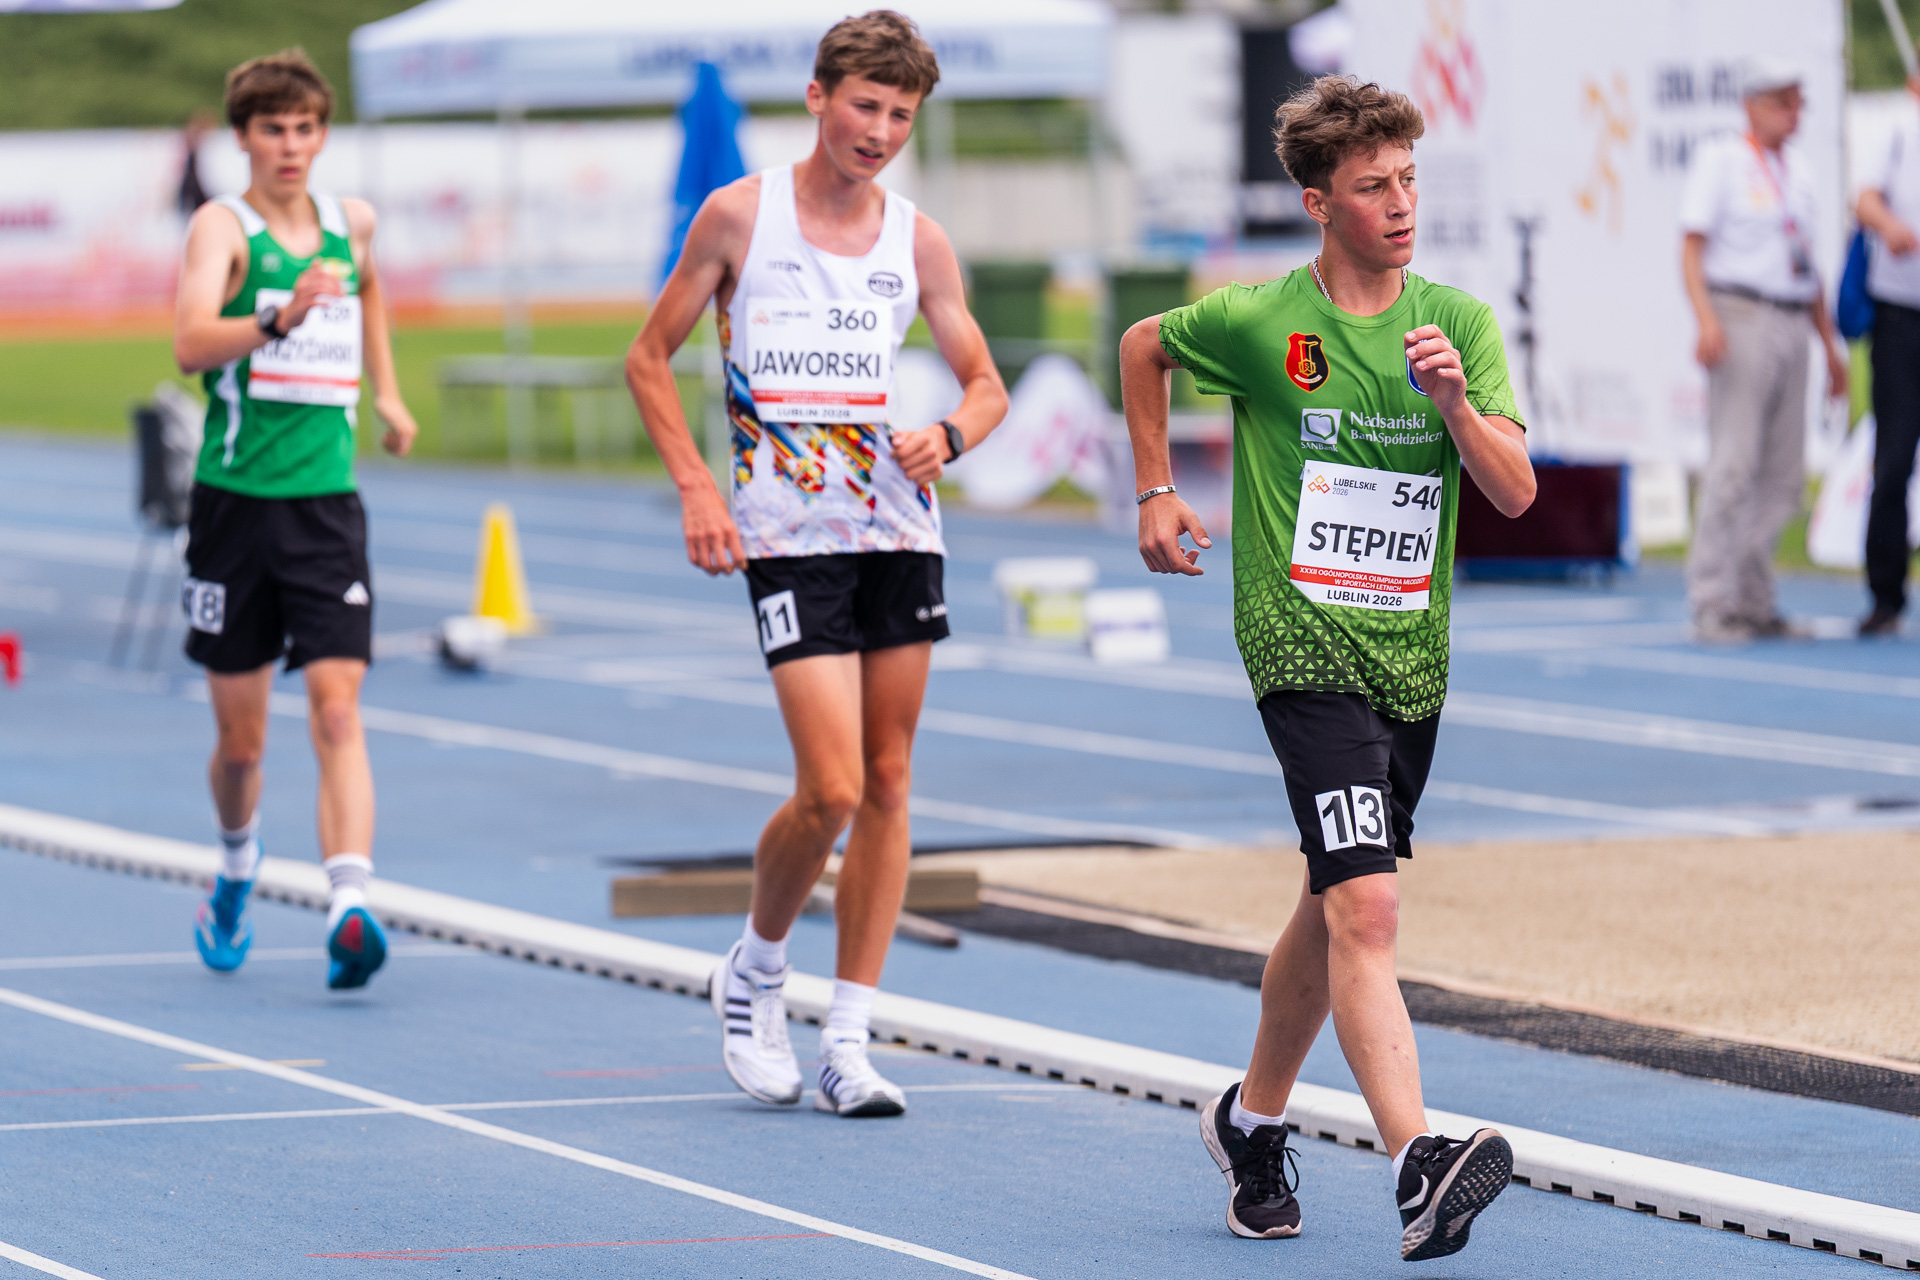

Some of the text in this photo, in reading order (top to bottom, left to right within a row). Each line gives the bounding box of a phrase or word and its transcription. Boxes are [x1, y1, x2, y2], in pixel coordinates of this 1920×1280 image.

[827, 307, 877, 331] 360
[752, 350, 881, 378] JAWORSKI
[1350, 411, 1426, 430] Nadsański
[1301, 441, 1339, 452] SANBank
[1332, 487, 1349, 496] 2026
[1333, 477, 1378, 491] LUBELSKIE
[1391, 481, 1442, 511] 540
[1307, 520, 1433, 563] STĘPIEŃ
[1299, 566, 1318, 575] XXXII
[1318, 568, 1368, 581] OGÓLNOPOLSKA
[1369, 574, 1403, 585] OLIMPIADA
[1334, 578, 1402, 592] W SPORTACH LETNICH
[1326, 589, 1403, 607] LUBLIN 2026
[759, 602, 791, 640] 11
[1321, 791, 1383, 844] 13
